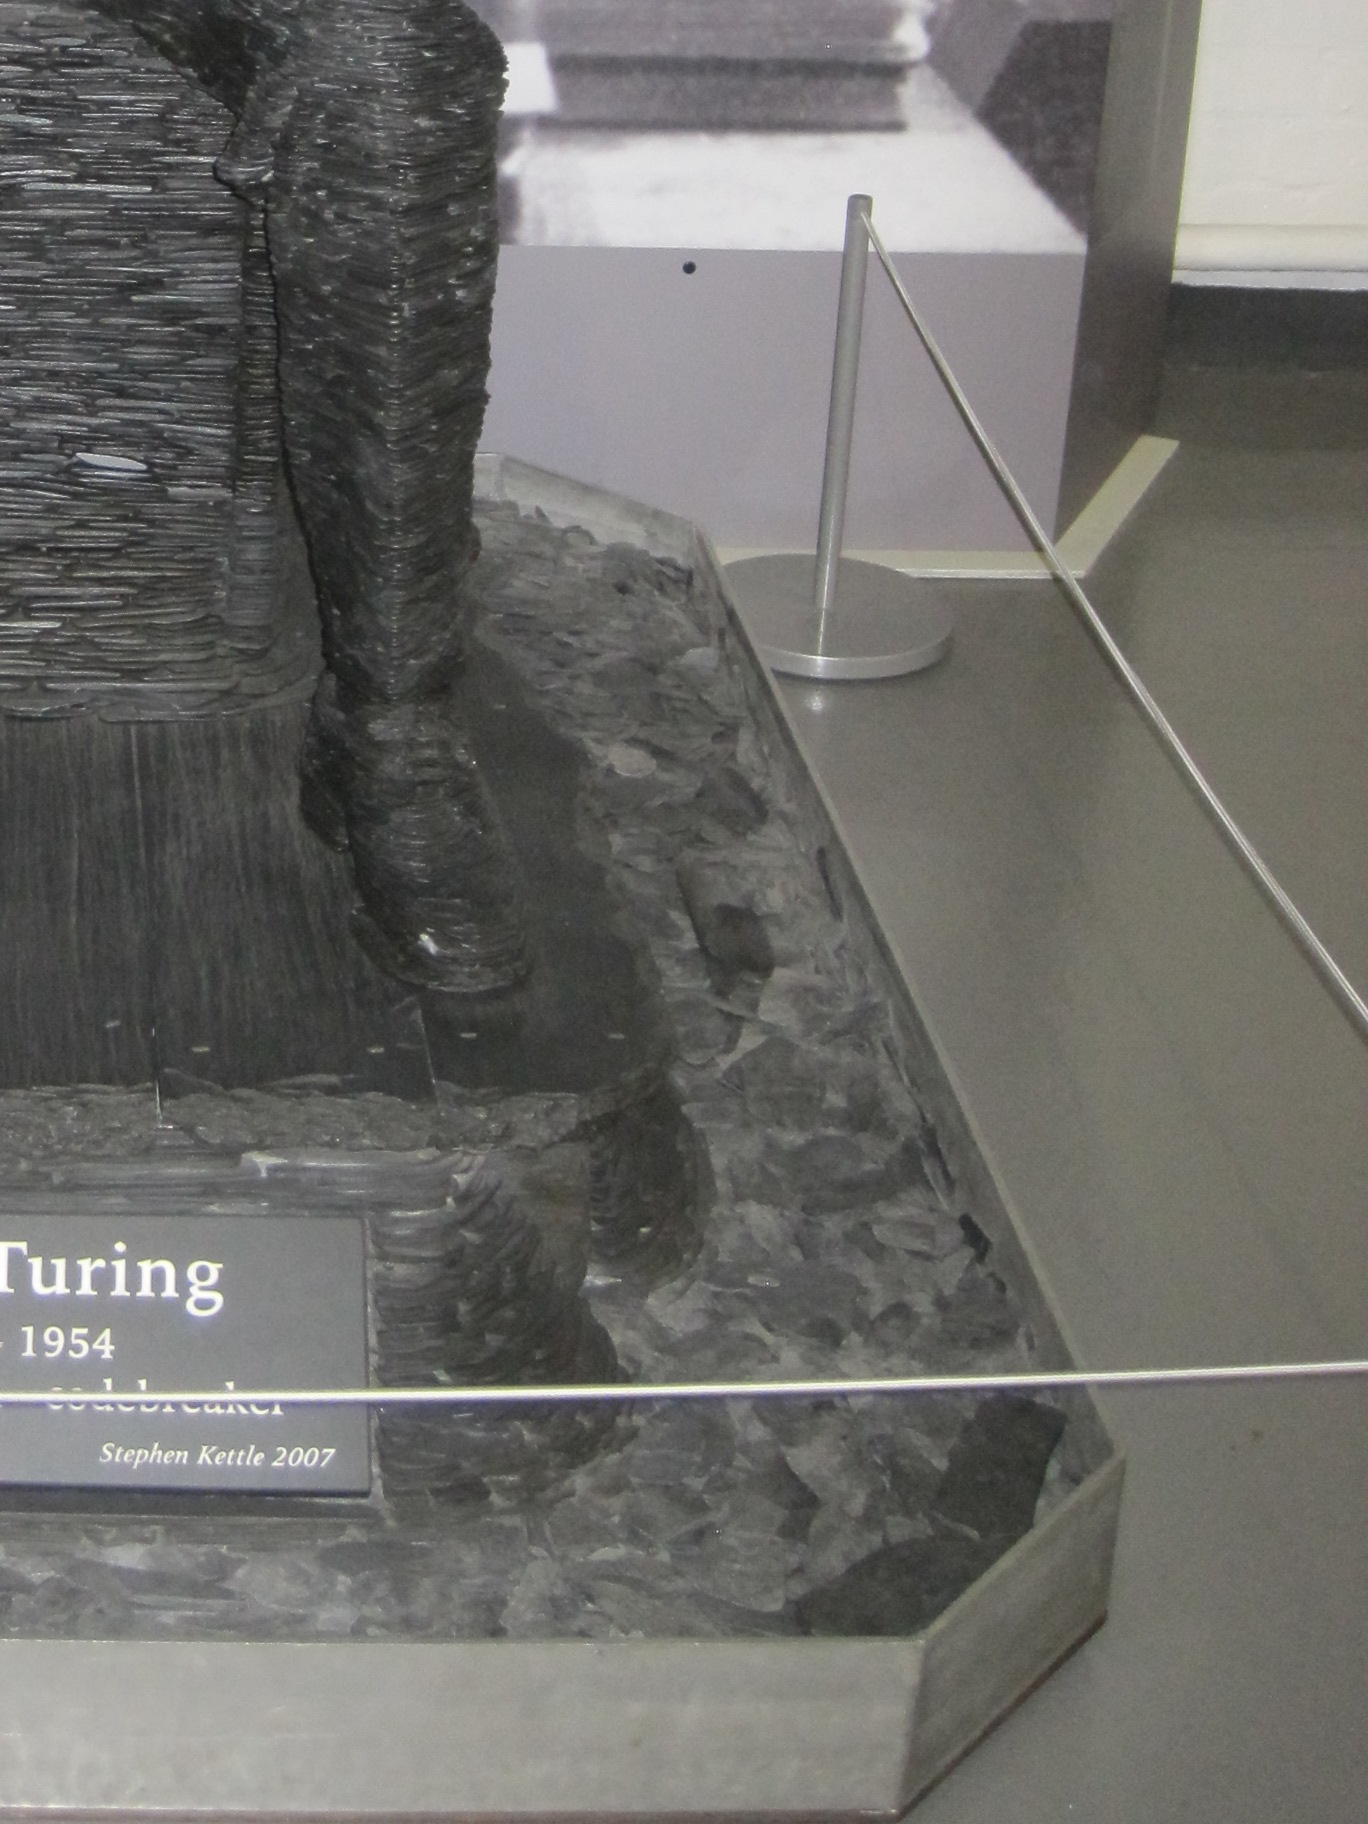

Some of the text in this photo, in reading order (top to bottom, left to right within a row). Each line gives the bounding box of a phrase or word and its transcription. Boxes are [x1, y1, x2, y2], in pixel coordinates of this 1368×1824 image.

[20, 1325, 116, 1360] 1954
[98, 1441, 337, 1469] Stephen Kettle 2007
